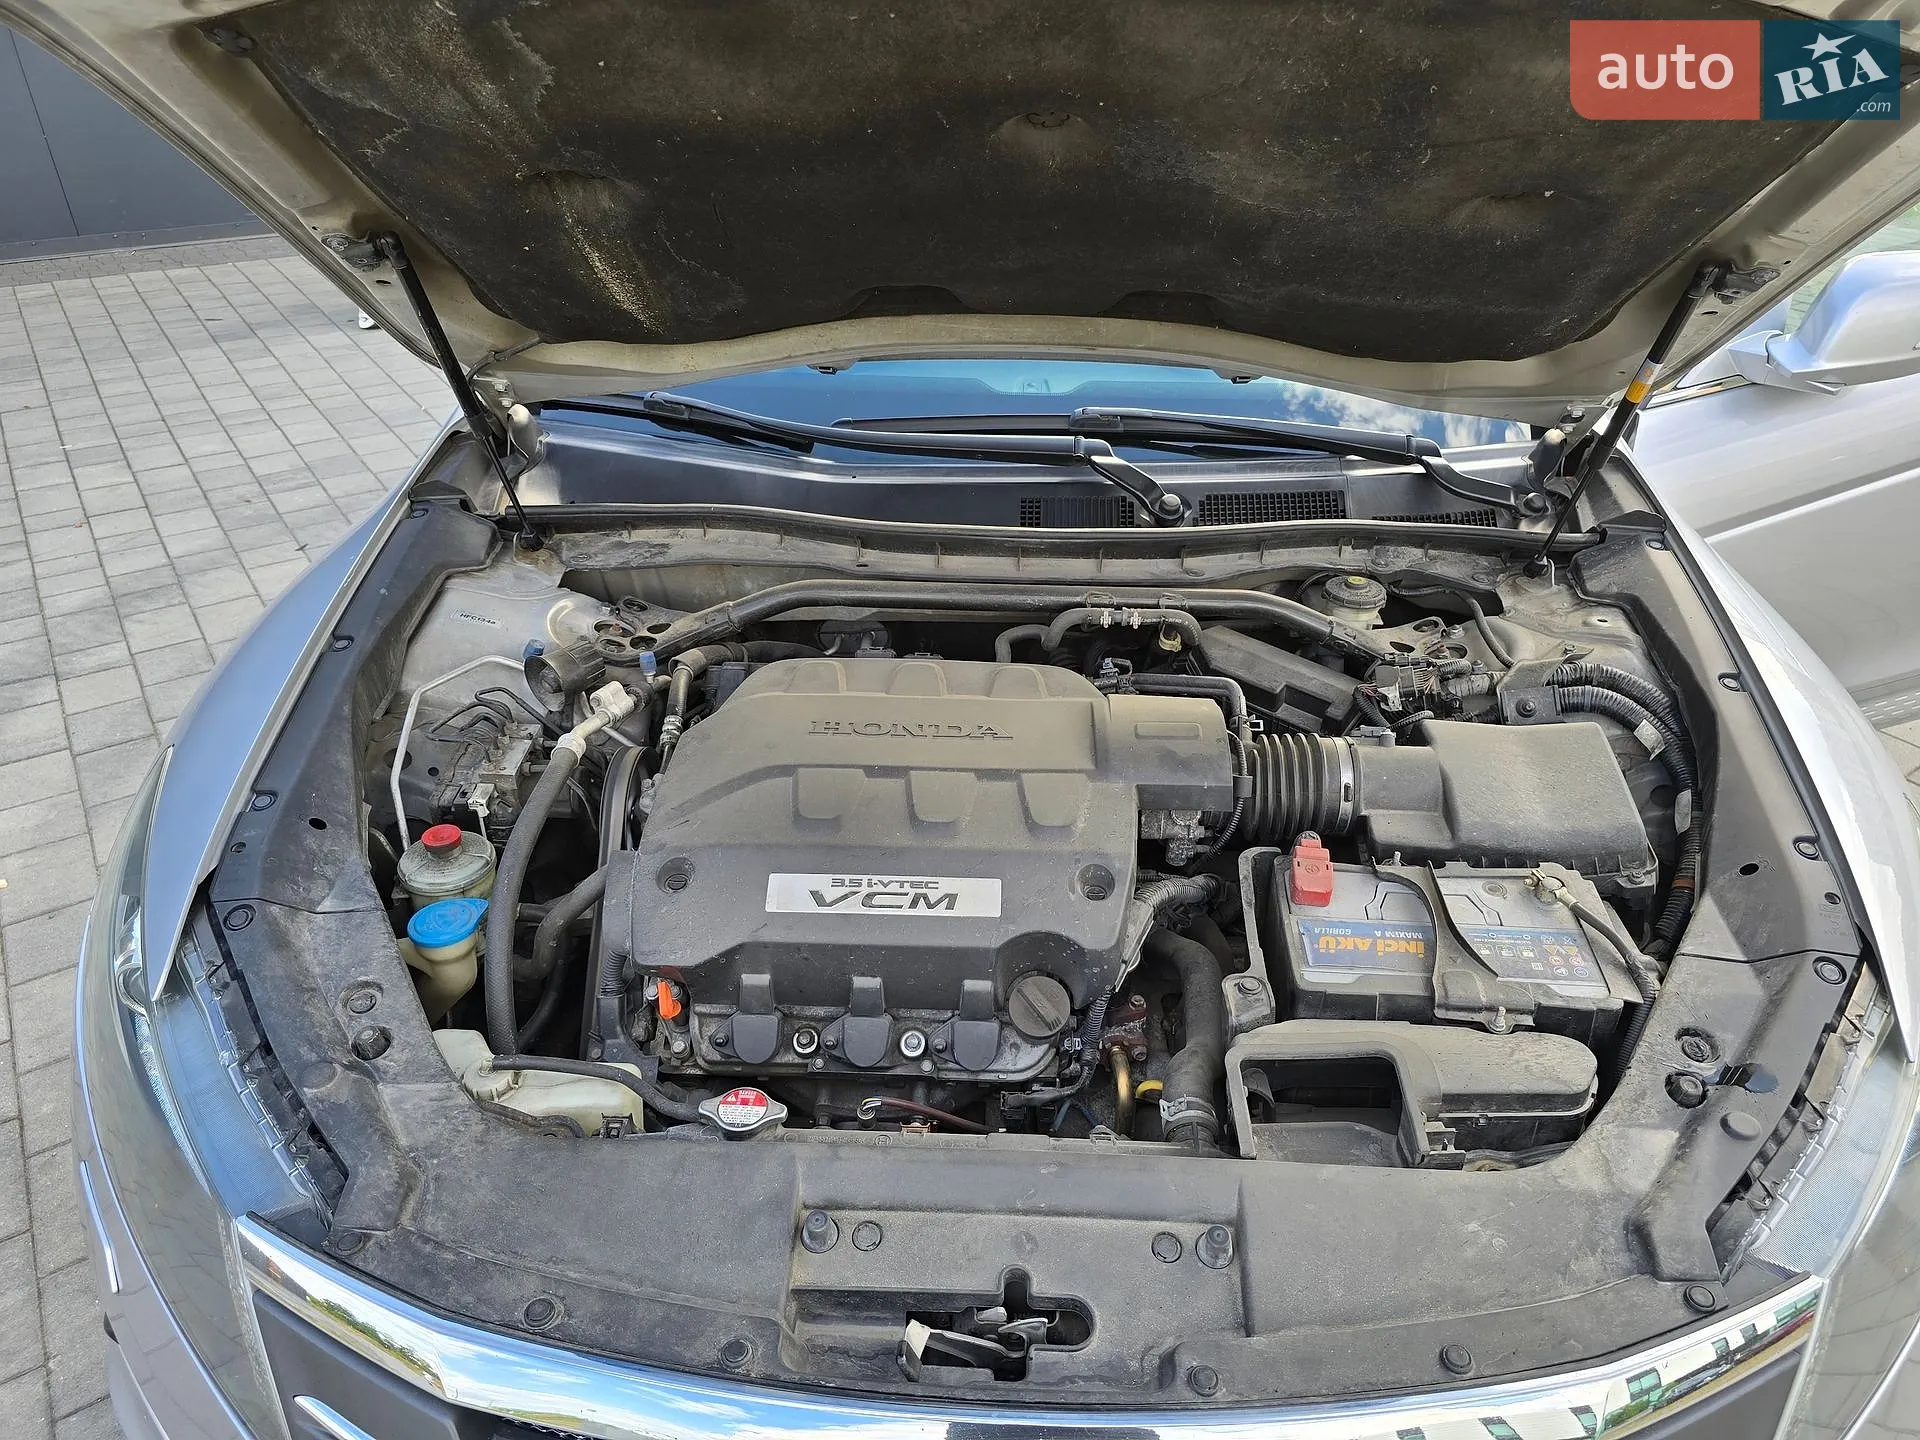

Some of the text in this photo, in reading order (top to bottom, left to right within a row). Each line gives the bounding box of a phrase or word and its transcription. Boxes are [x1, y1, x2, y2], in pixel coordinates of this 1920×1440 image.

[808, 720, 1014, 741] HONDA
[830, 878, 940, 890] 3.5 i-VTEC
[807, 889, 960, 911] VCM
[1314, 927, 1352, 935] GORILLA
[1319, 936, 1372, 953] AKÜ
